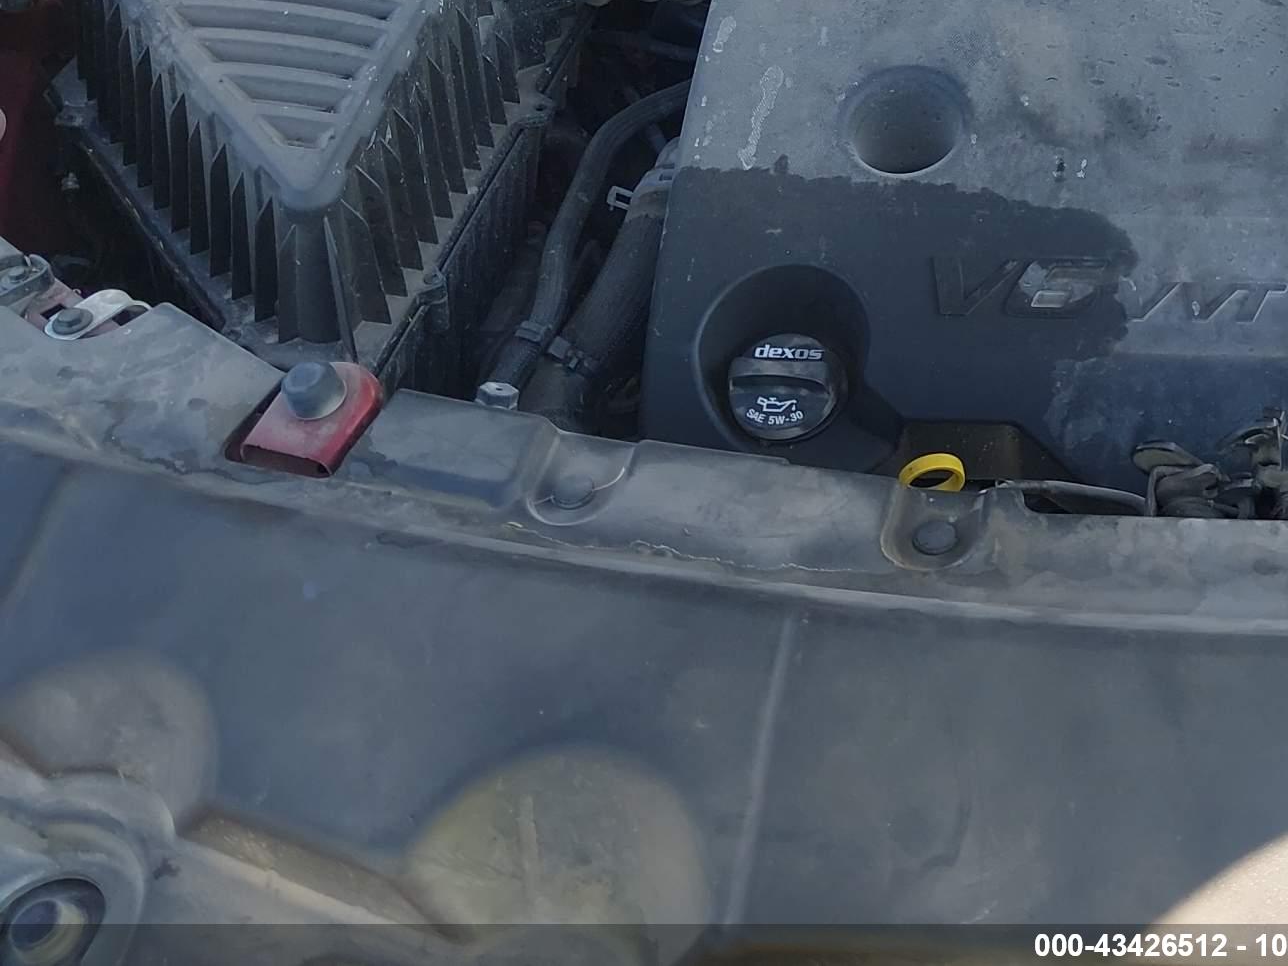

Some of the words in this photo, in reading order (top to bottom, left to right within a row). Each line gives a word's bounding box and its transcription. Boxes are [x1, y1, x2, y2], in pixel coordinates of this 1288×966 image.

[930, 256, 1112, 319] V6
[754, 344, 824, 360] dexos
[746, 408, 766, 423] SAE
[767, 410, 804, 425] 5W-30
